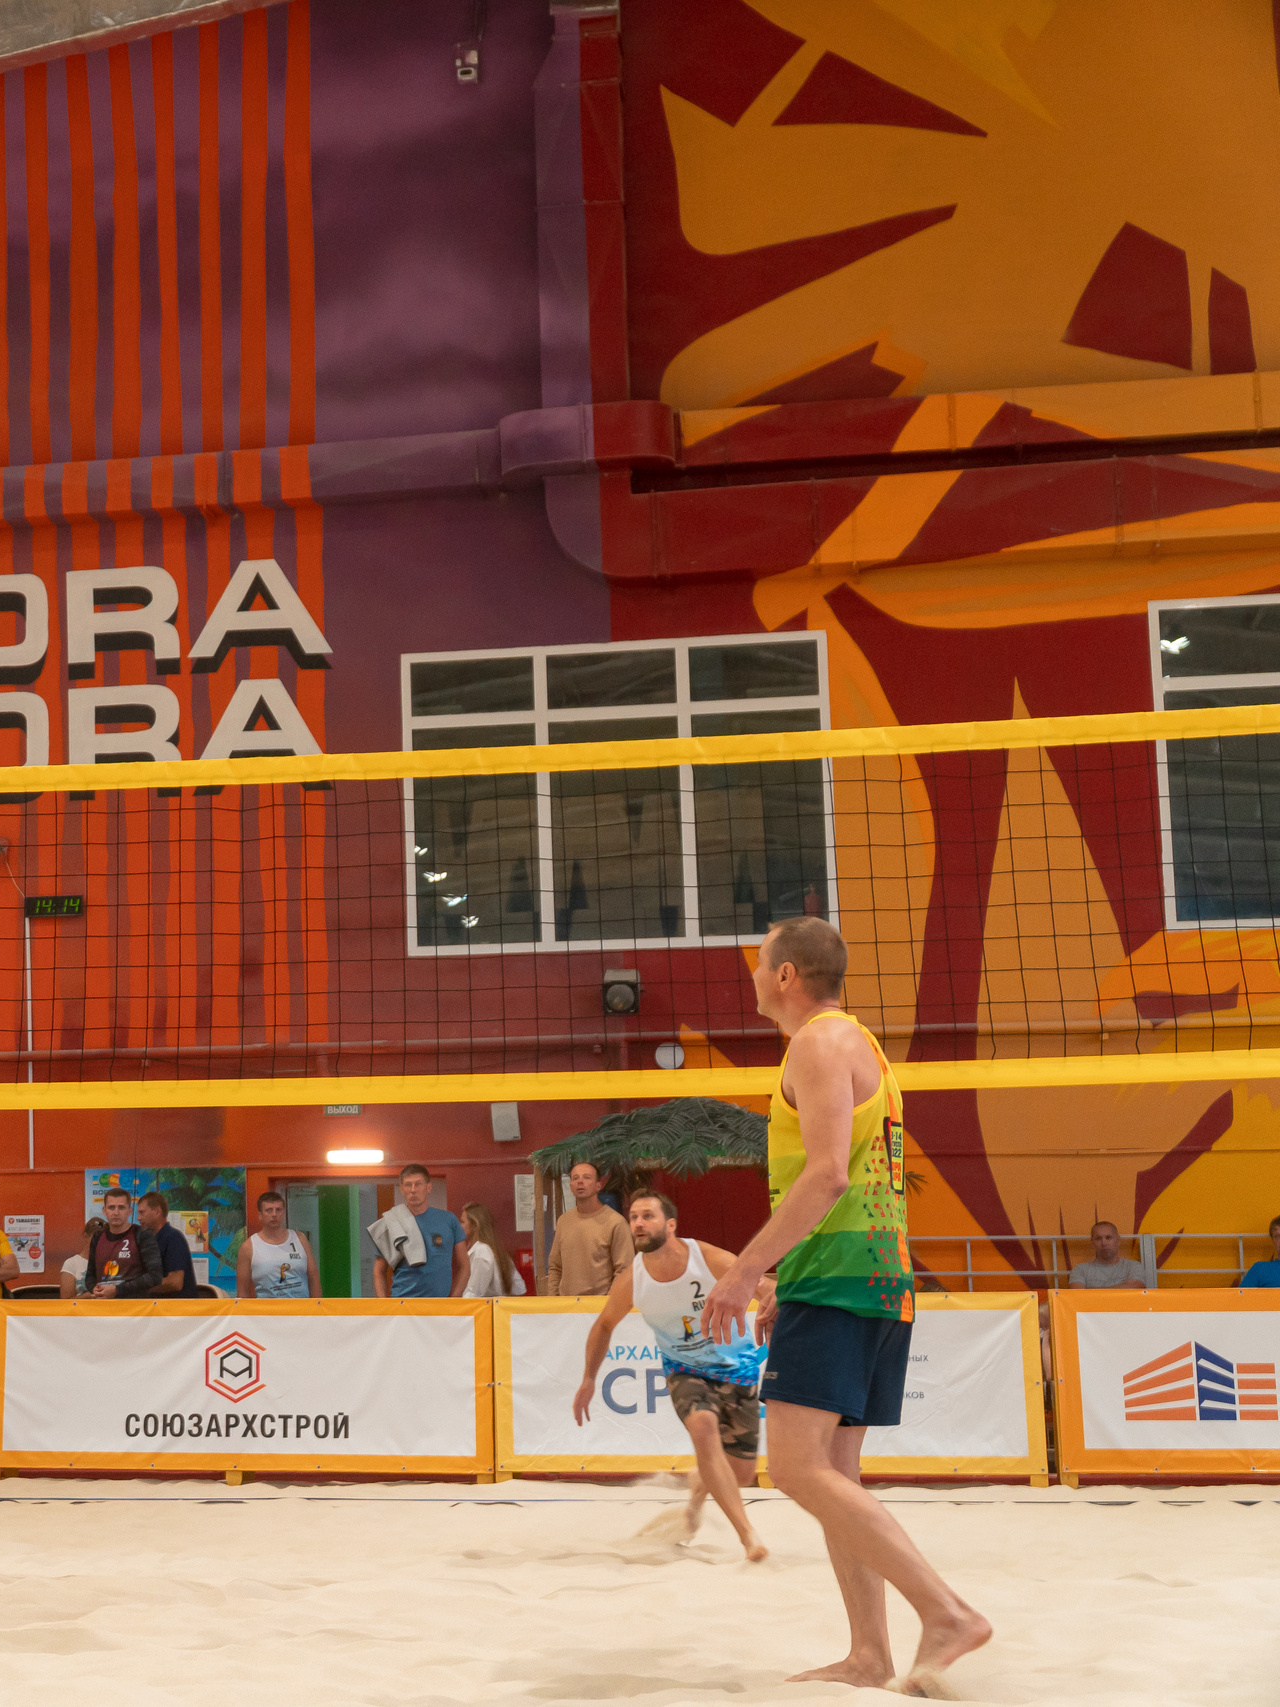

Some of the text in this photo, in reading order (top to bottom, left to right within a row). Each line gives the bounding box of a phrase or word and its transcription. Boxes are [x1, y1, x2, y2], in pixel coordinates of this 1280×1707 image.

[35, 898, 80, 914] 14:14
[327, 1105, 359, 1114] ВЫХОД
[121, 1239, 130, 1251] 2
[289, 1242, 297, 1252] 1
[118, 1251, 131, 1259] RUS
[690, 1280, 705, 1299] 2
[692, 1299, 706, 1312] RU
[908, 1354, 929, 1362] НЫХ
[601, 1367, 671, 1415] СР
[125, 1412, 350, 1439] СОЮЗАРХСТРОЙ
